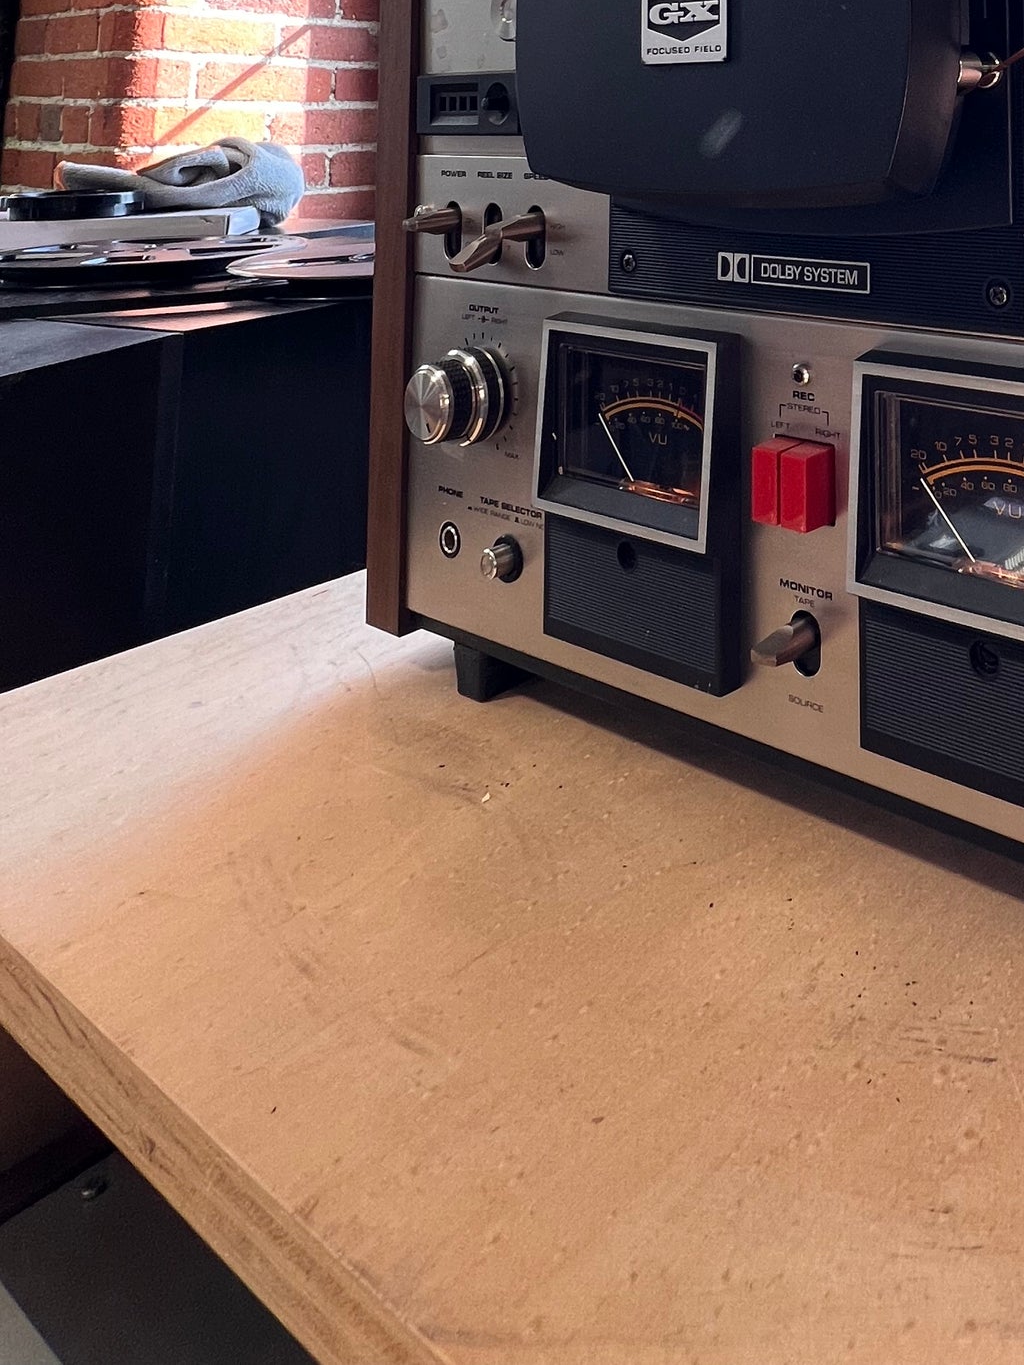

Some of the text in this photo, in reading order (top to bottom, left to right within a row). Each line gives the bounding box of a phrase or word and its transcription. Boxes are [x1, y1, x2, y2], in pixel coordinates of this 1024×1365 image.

[646, 43, 722, 55] FOCUSED FIELD
[440, 169, 467, 178] POWER
[477, 171, 495, 179] REEL
[760, 262, 858, 285] DOLBY SYSTEM
[469, 304, 499, 314] OUTPUT
[793, 390, 815, 402] REC
[786, 402, 820, 414] STEREO
[771, 420, 790, 429] LEFT
[649, 432, 668, 446] VU
[911, 449, 927, 461] 20
[935, 441, 948, 452] 10
[968, 434, 977, 445] 5
[990, 435, 999, 446] 3
[1005, 437, 1014, 448] 2
[438, 485, 464, 498] PHONE
[480, 496, 543, 519] TAPE SELECTOR
[993, 501, 1022, 519] VU
[780, 578, 833, 601] MONITOR
[794, 595, 815, 608] TAPE
[788, 693, 824, 713] SOURCE
